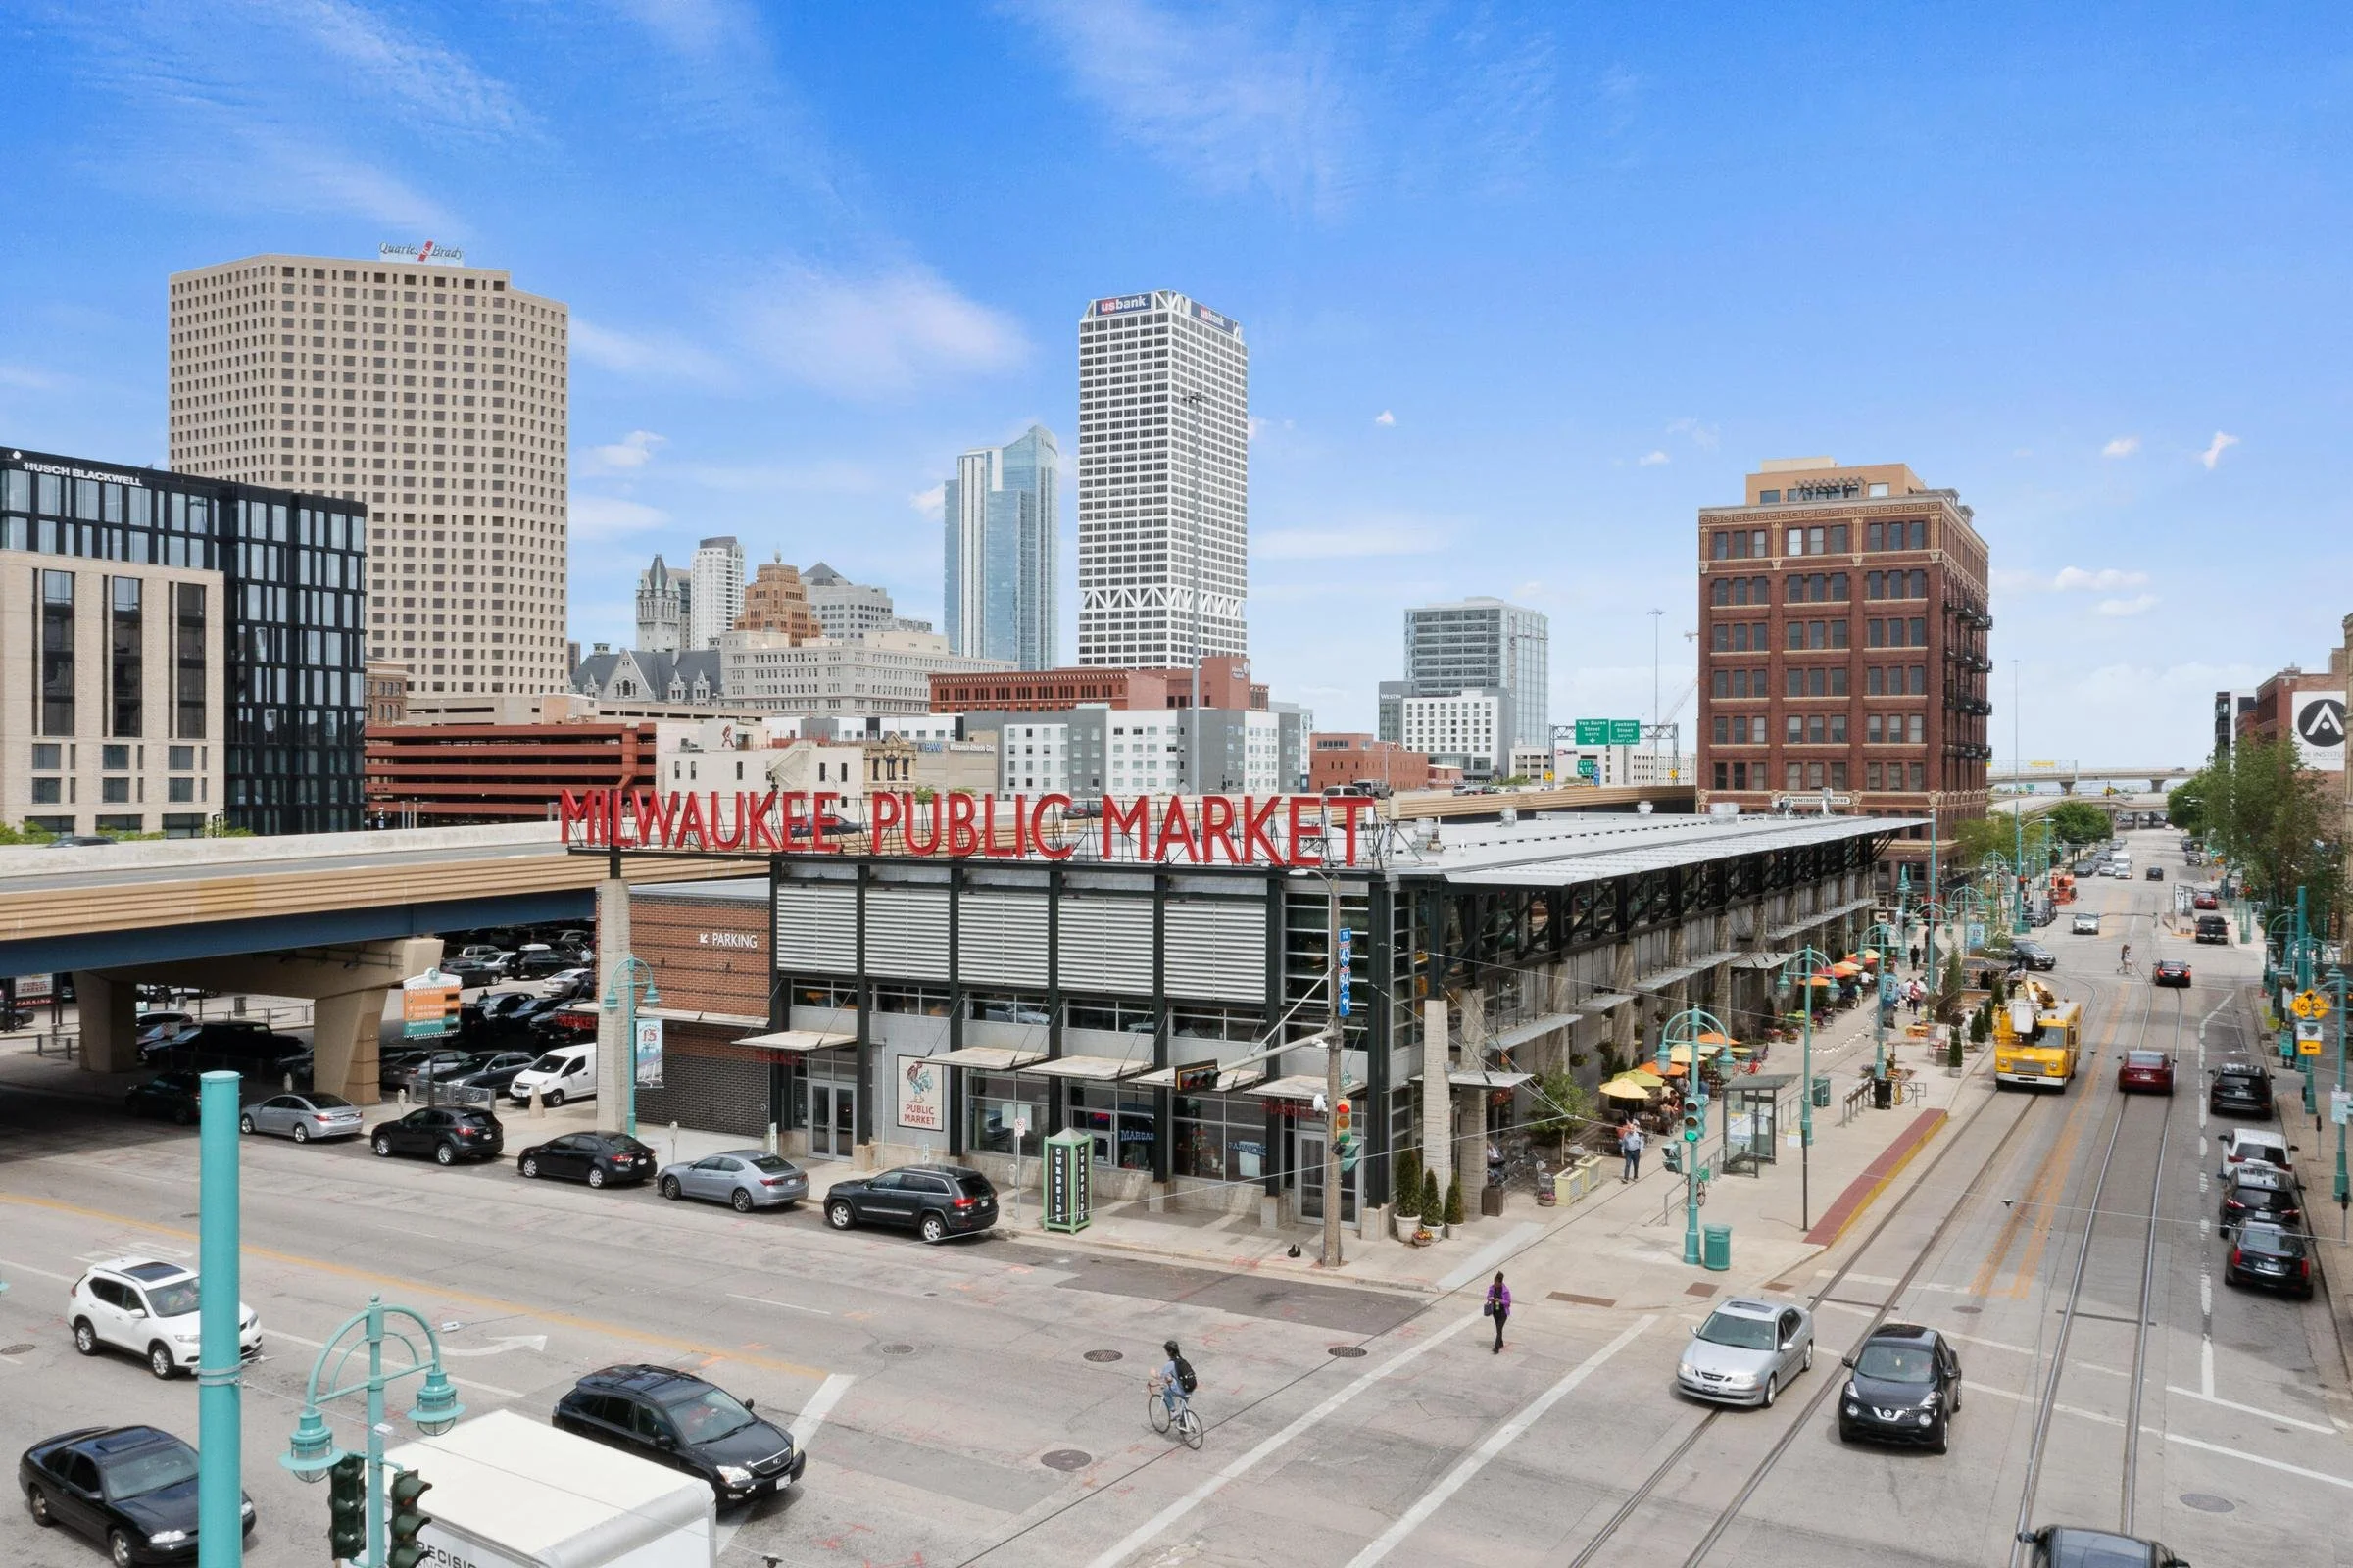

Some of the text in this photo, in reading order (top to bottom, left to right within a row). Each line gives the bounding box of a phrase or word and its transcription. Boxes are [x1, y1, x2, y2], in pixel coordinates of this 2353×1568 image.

[378, 242, 464, 260] Quarles Brady
[24, 462, 142, 486] HUSCH BLACKWELL
[561, 788, 1374, 867] MILWAUKEE PUBLIC MARKET
[712, 933, 758, 949] PARKING
[1342, 931, 1349, 940] TO
[1341, 949, 1350, 962] 43
[1341, 973, 1350, 987] 94
[16, 998, 51, 1006] PARKING
[643, 1029, 658, 1042] 15
[906, 1103, 935, 1115] PUBLIC
[904, 1114, 936, 1126] MARKET
